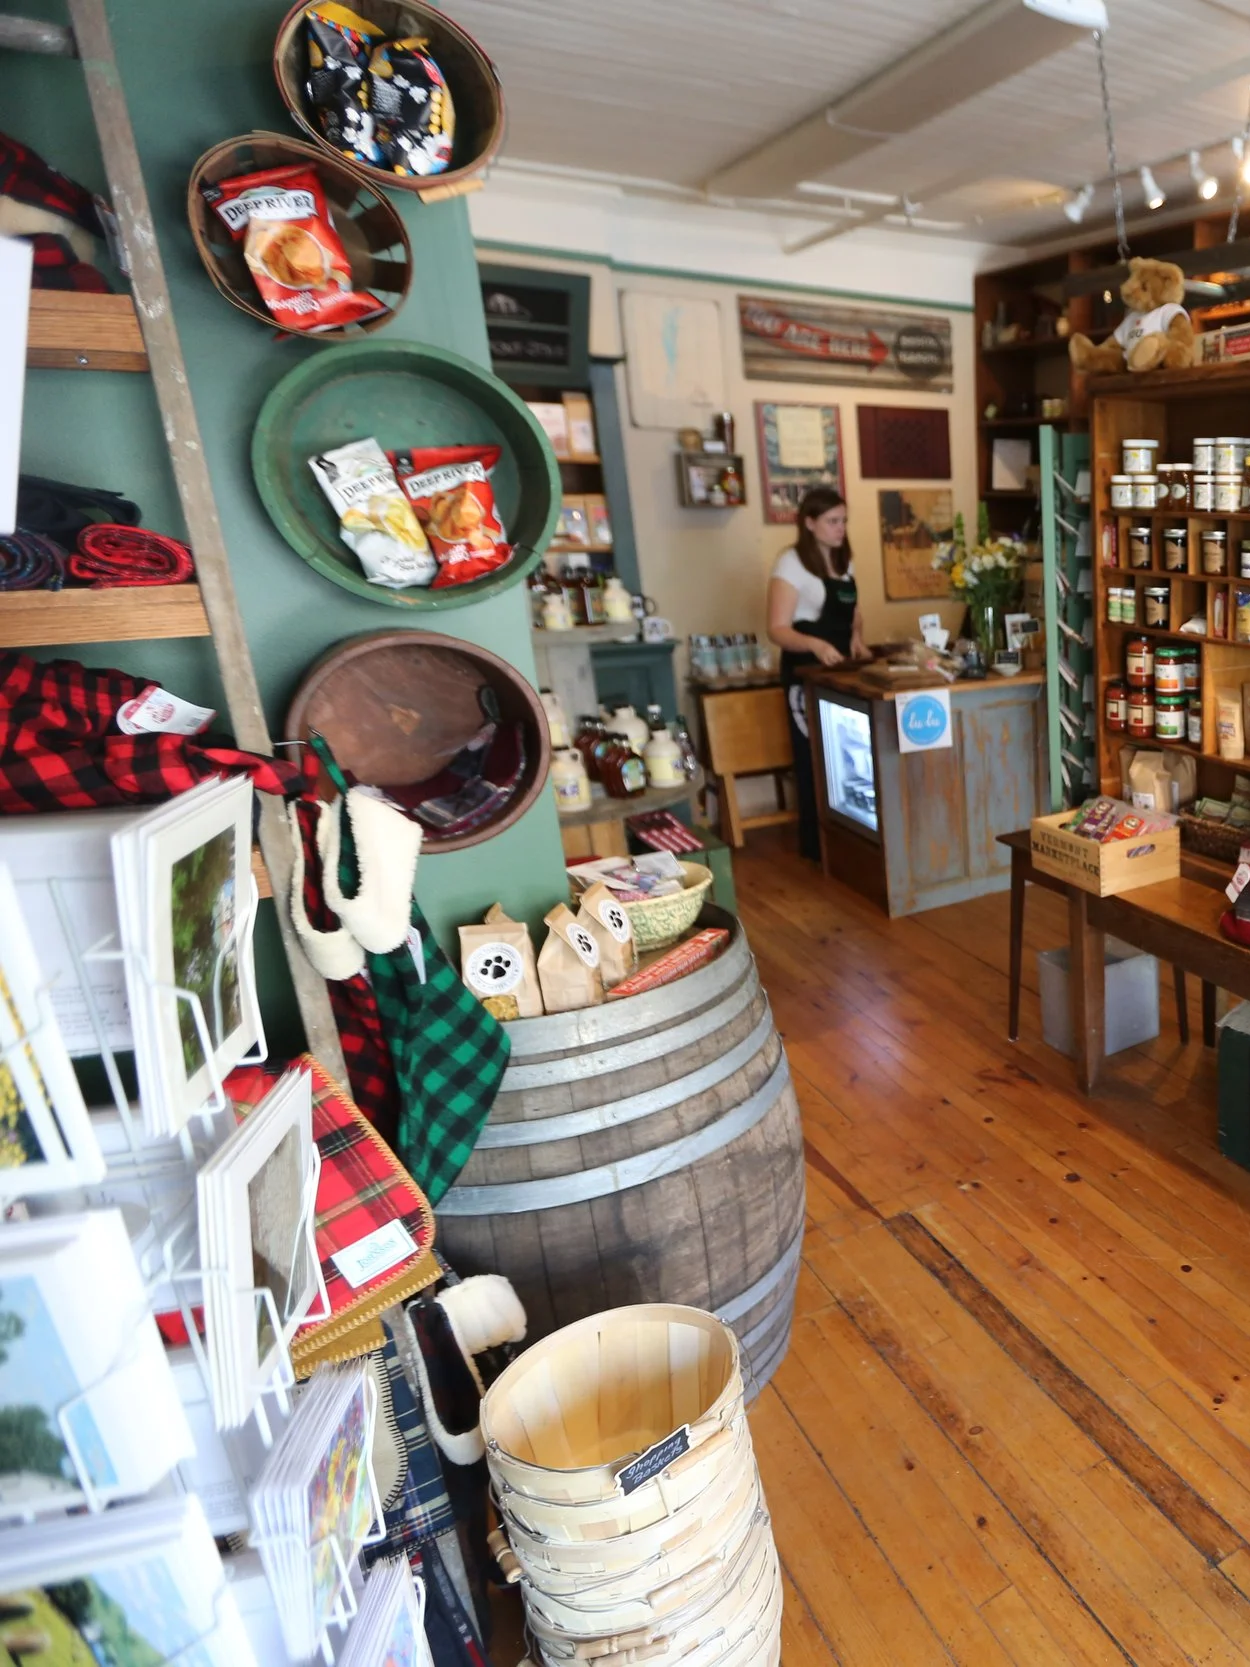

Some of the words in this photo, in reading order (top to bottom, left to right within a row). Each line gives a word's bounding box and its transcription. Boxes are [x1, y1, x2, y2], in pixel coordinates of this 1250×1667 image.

[224, 197, 264, 222] DEEP
[409, 473, 442, 493] DEEP
[1032, 841, 1100, 876] MARKETPLACE
[626, 1436, 682, 1479] Shopping
[632, 1445, 684, 1485] Baskets
